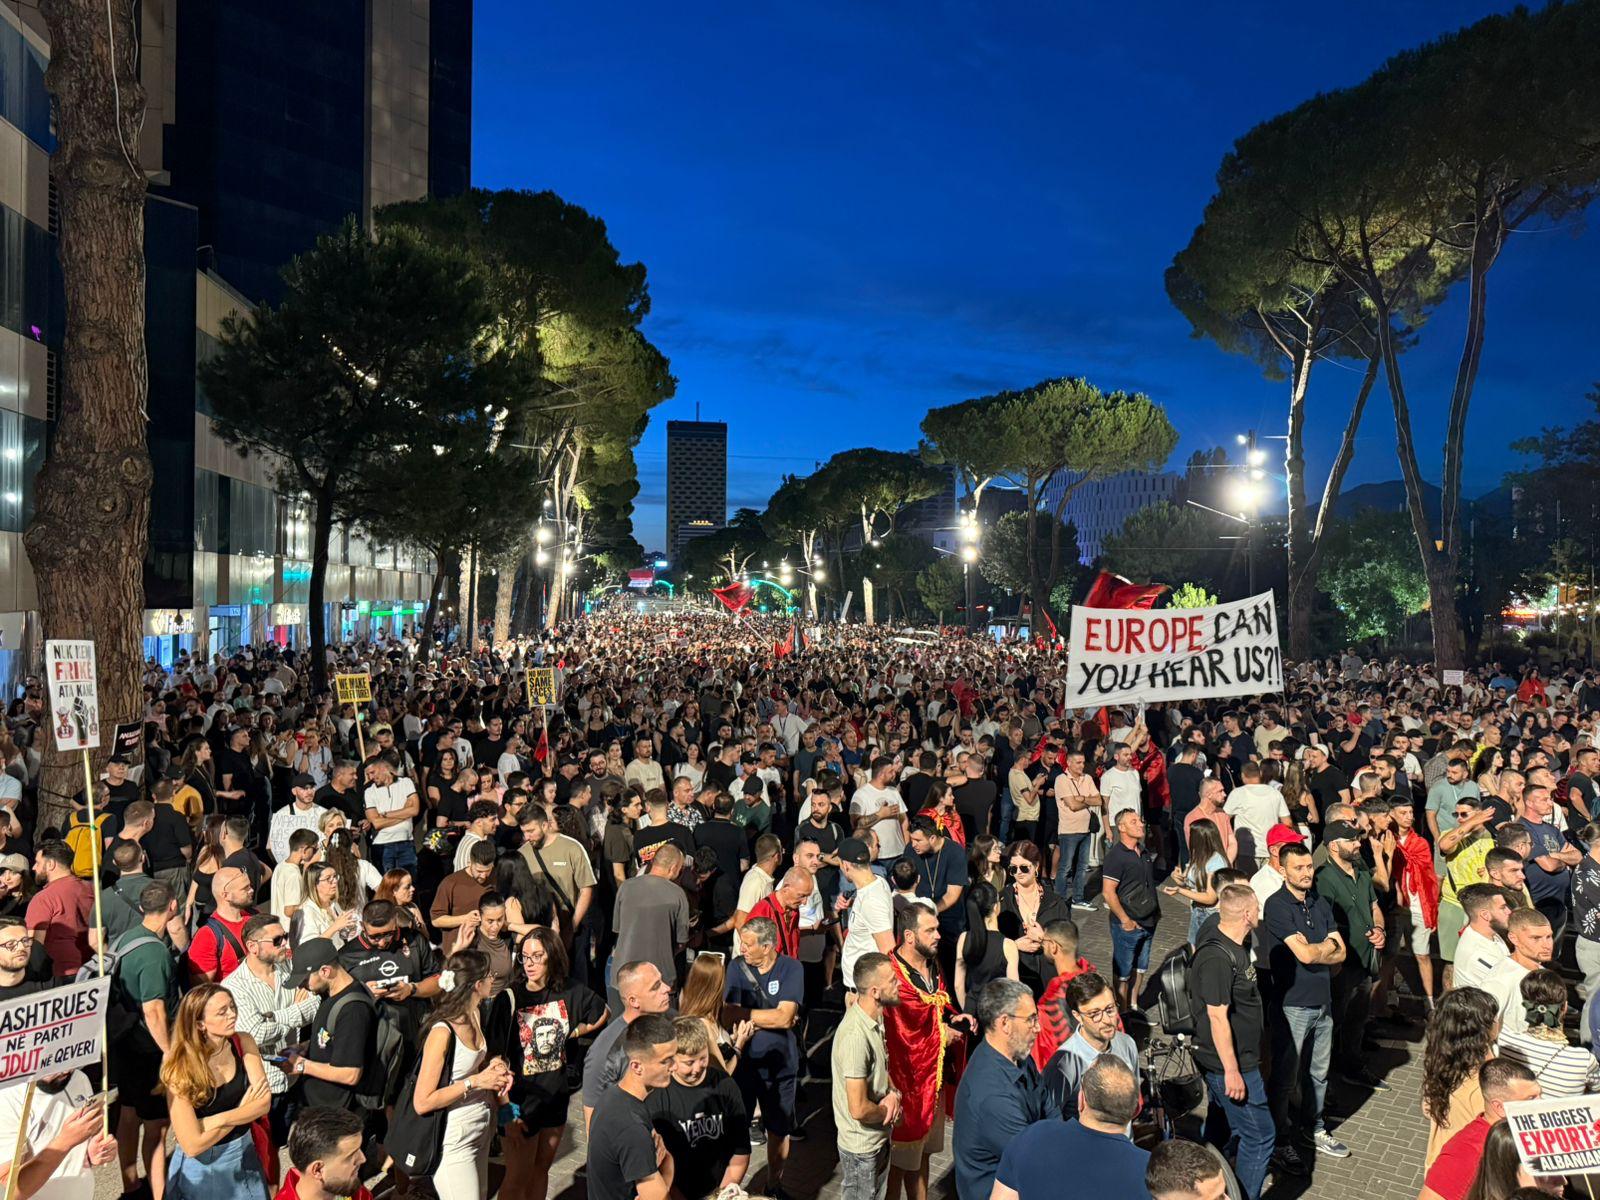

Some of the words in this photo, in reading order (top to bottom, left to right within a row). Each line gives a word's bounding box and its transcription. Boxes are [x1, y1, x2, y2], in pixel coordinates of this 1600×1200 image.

[1084, 615, 1208, 654] EUROPE
[1213, 601, 1272, 643] CAN
[529, 677, 553, 688] SAME
[1077, 662, 1141, 695] YOU
[1148, 650, 1231, 688] HEAR
[1234, 646, 1280, 685] US?!
[6, 1033, 26, 1053] NË
[33, 1022, 73, 1047] PARTI
[54, 1039, 96, 1063] QEVERI
[678, 1112, 725, 1147] VENOM
[1512, 1114, 1538, 1131] THE
[1538, 1106, 1595, 1129] BIGGEST
